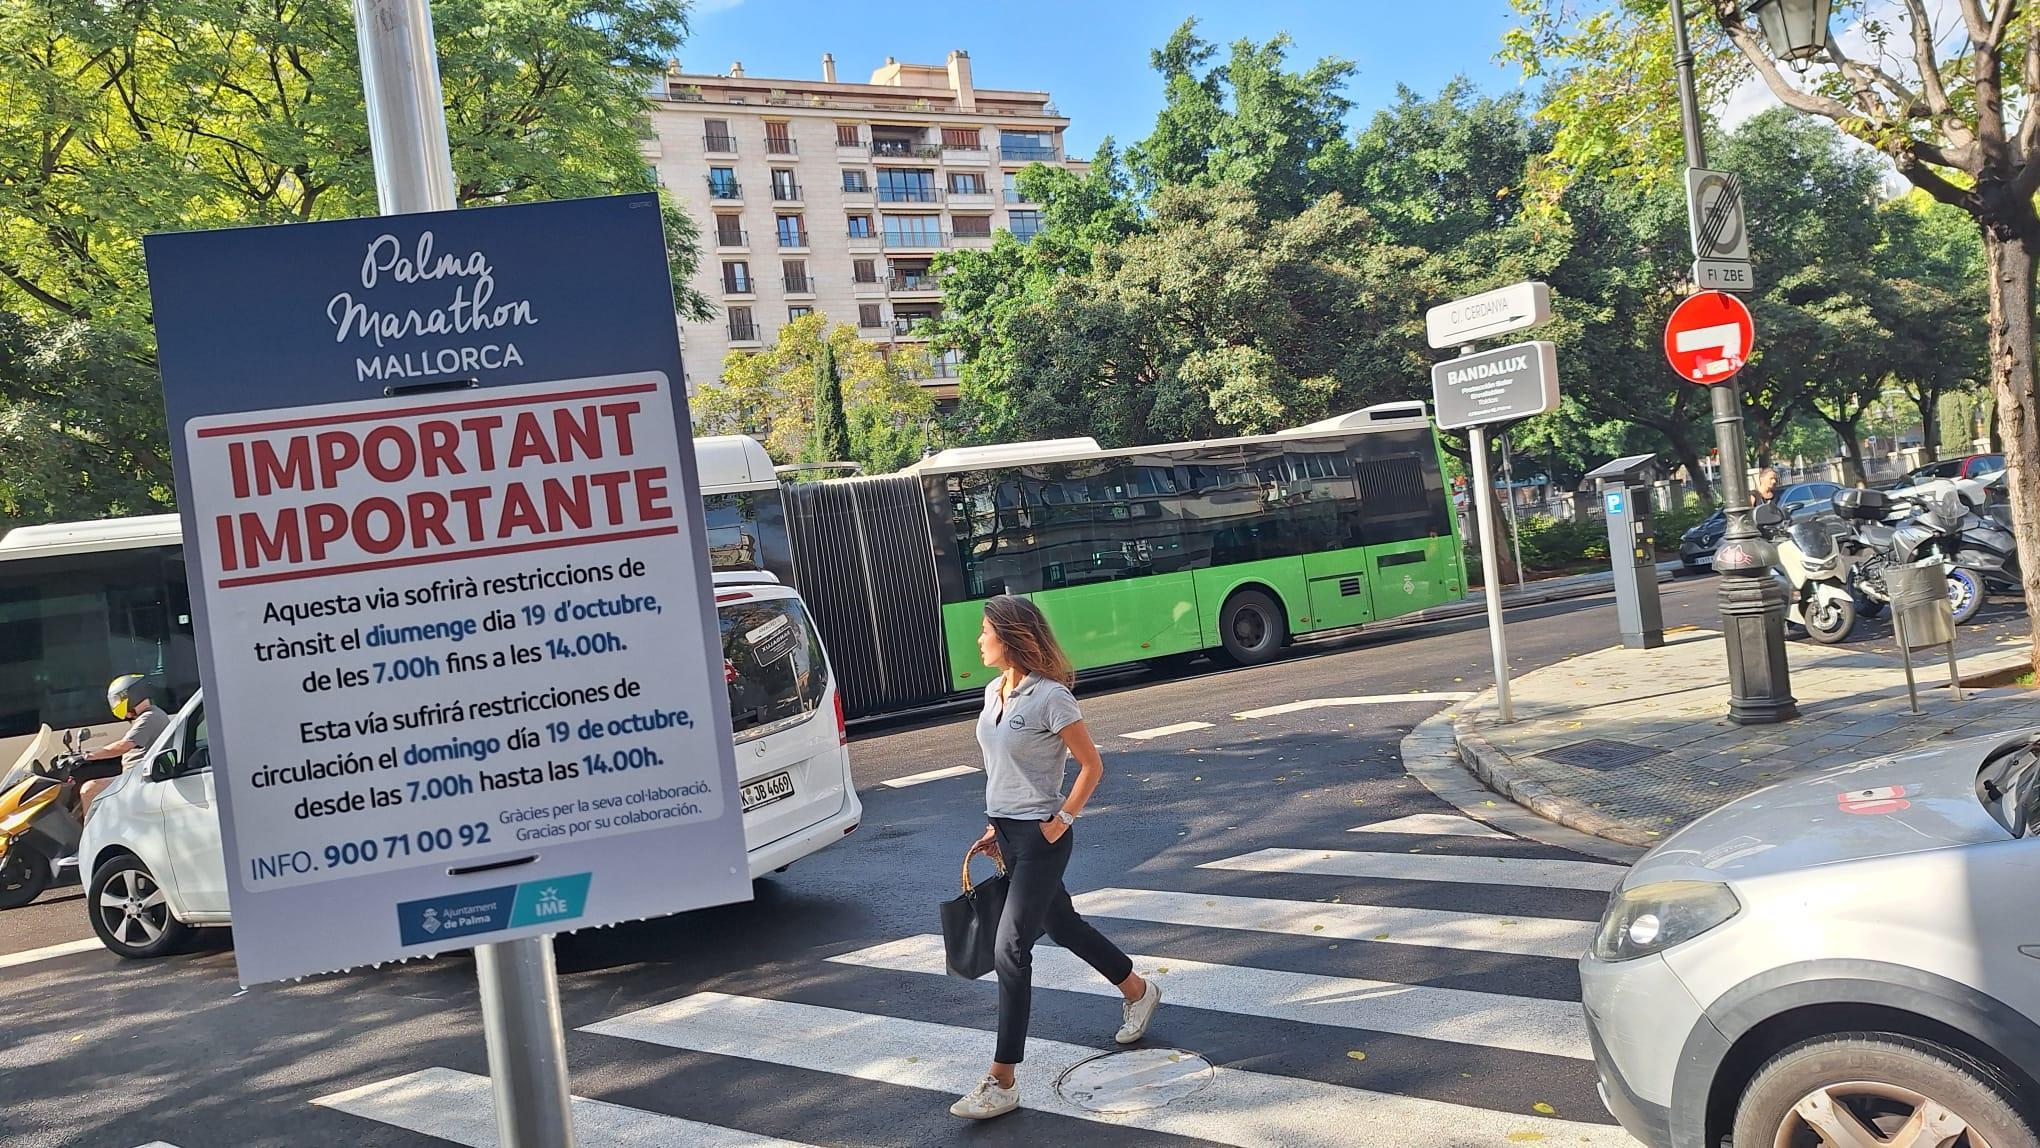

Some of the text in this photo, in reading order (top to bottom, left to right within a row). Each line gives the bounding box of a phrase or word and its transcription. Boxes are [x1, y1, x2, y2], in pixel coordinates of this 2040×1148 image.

[362, 231, 493, 289] Palma
[1708, 268, 1744, 281] FI ZBE
[327, 276, 538, 347] Marathon
[1464, 297, 1509, 321] CERDANYA
[357, 344, 524, 382] MALLORCA
[1447, 355, 1528, 386] BANDALUX
[228, 402, 641, 498] IMPORTANT
[216, 466, 673, 571] IMPORTANTE
[263, 557, 646, 626] Aquesta via sofrirà restriccions de
[254, 631, 337, 662] trànsit
[341, 628, 361, 650] el
[366, 618, 477, 647] diumenge
[483, 609, 516, 632] dia
[522, 604, 546, 626] 19
[302, 632, 627, 693] de les 7.00h fins a les 14.00h.
[300, 678, 641, 744] Esta vía sufrirá restricciones de
[251, 709, 694, 788] circulación el domingo día 19 de octubre,
[294, 747, 664, 820] desde las 7.00h hasta las 14.00h.
[499, 806, 550, 825] Gràcies
[552, 803, 575, 820] per
[578, 796, 590, 813] la
[592, 796, 623, 810] seva
[754, 785, 767, 801] JB
[767, 776, 789, 796] 4669
[516, 802, 702, 841] Gracias por su colaboración.
[251, 822, 491, 881] INFO. 900 71 00 92
[443, 902, 497, 918] Ajuntament
[444, 915, 491, 930] de Palma
[535, 899, 568, 917] IME
